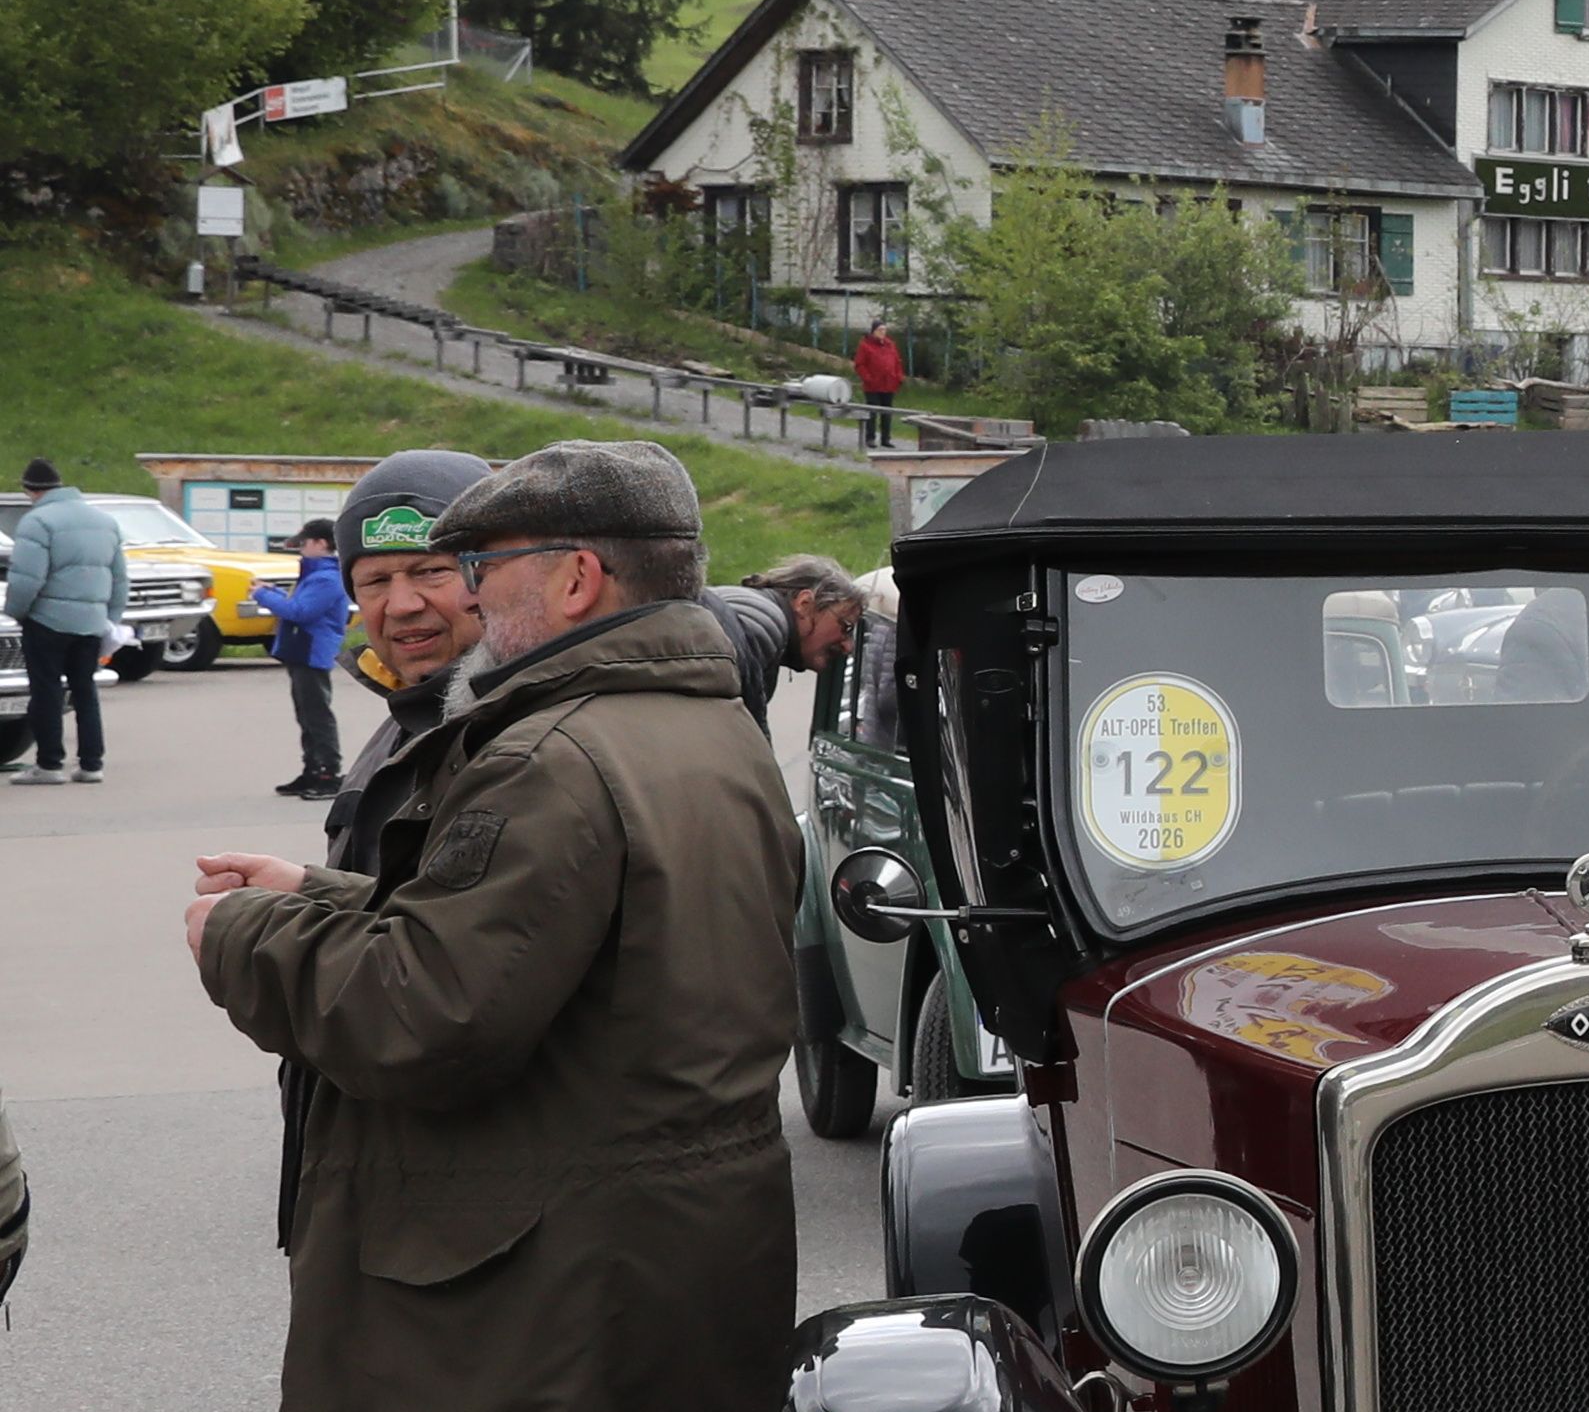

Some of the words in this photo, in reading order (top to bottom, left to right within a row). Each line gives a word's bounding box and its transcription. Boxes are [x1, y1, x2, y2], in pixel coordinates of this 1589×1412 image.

[1495, 166, 1569, 205] Eggli
[1147, 694, 1170, 713] 53.
[1101, 719, 1165, 736] ALT-OPEL
[1171, 718, 1218, 736] Treffen
[1116, 750, 1209, 795] 122
[1120, 810, 1178, 824] Wildhaus
[1185, 810, 1203, 823] CH
[1138, 828, 1184, 849] 2026
